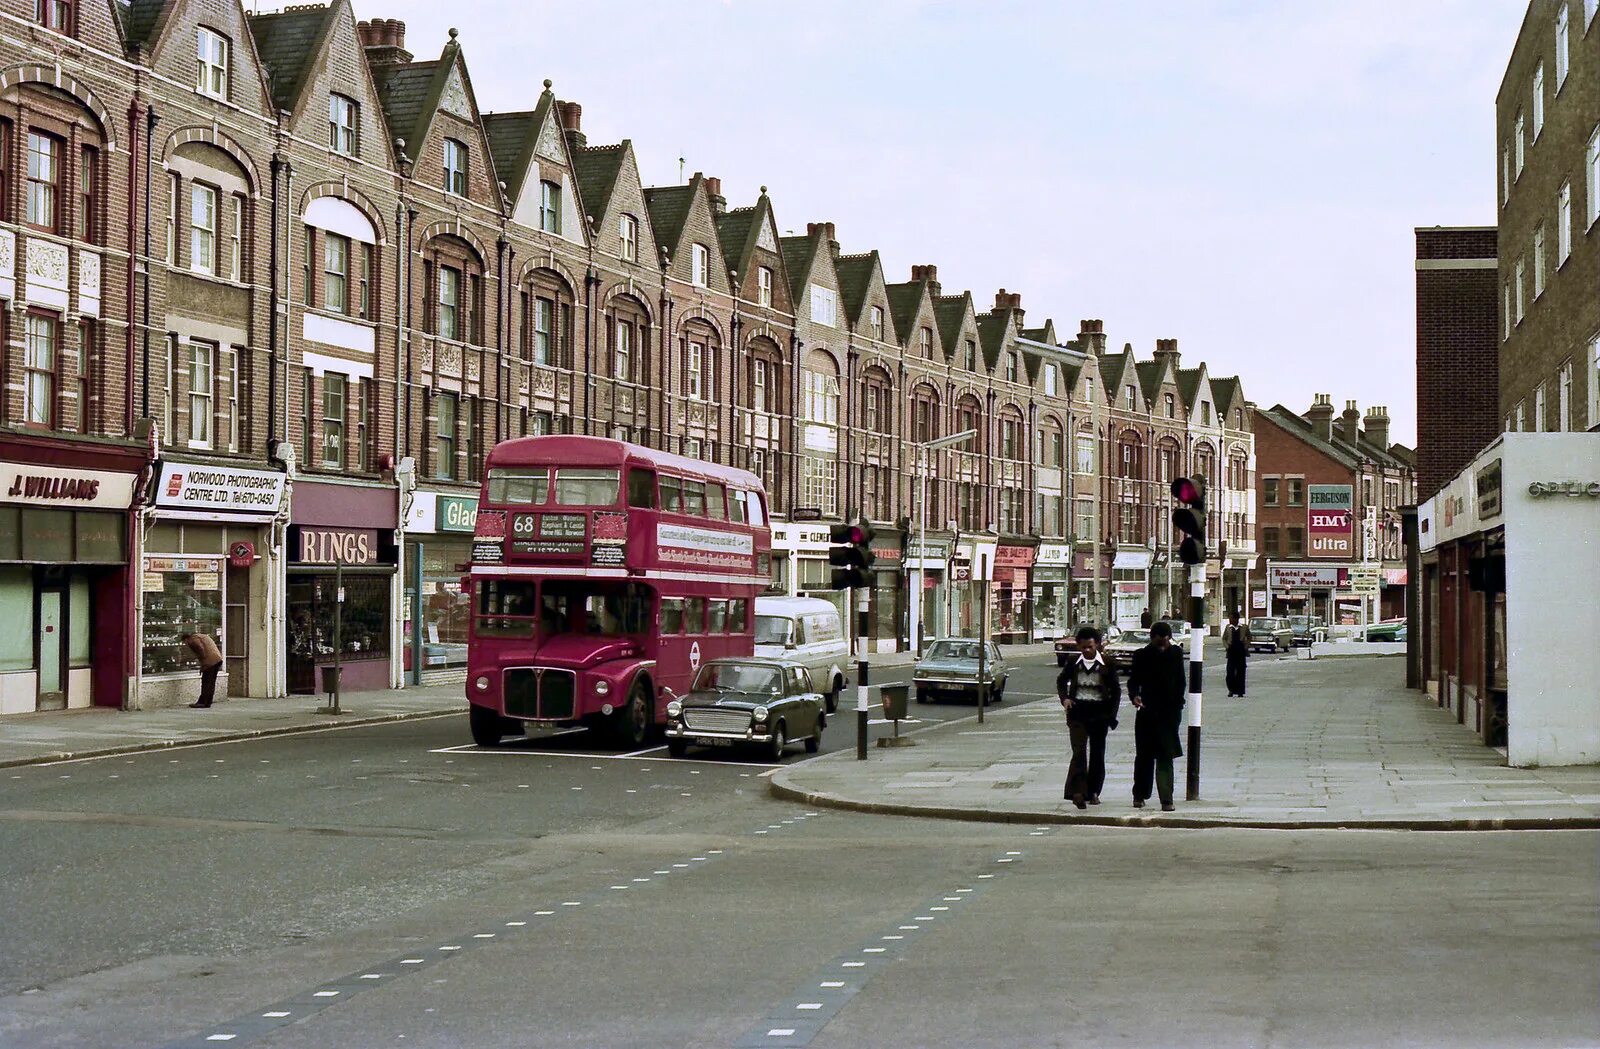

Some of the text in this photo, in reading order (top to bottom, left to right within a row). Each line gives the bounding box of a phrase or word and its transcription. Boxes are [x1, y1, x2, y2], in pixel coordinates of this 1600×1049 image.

[187, 471, 225, 486] NORWOOD
[227, 474, 279, 490] PHOTOGRAPHIC
[24, 476, 100, 501] WILLIAMS
[184, 487, 213, 502] CENTRE
[214, 490, 229, 503] LTD.
[1310, 492, 1351, 504] FERGUSON
[513, 516, 534, 532] 68
[1311, 515, 1347, 527] HMV
[301, 531, 368, 564] RINGS
[1313, 537, 1348, 550] ultra
[1275, 569, 1300, 577] Rental
[1280, 577, 1335, 585] Hire Purchase
